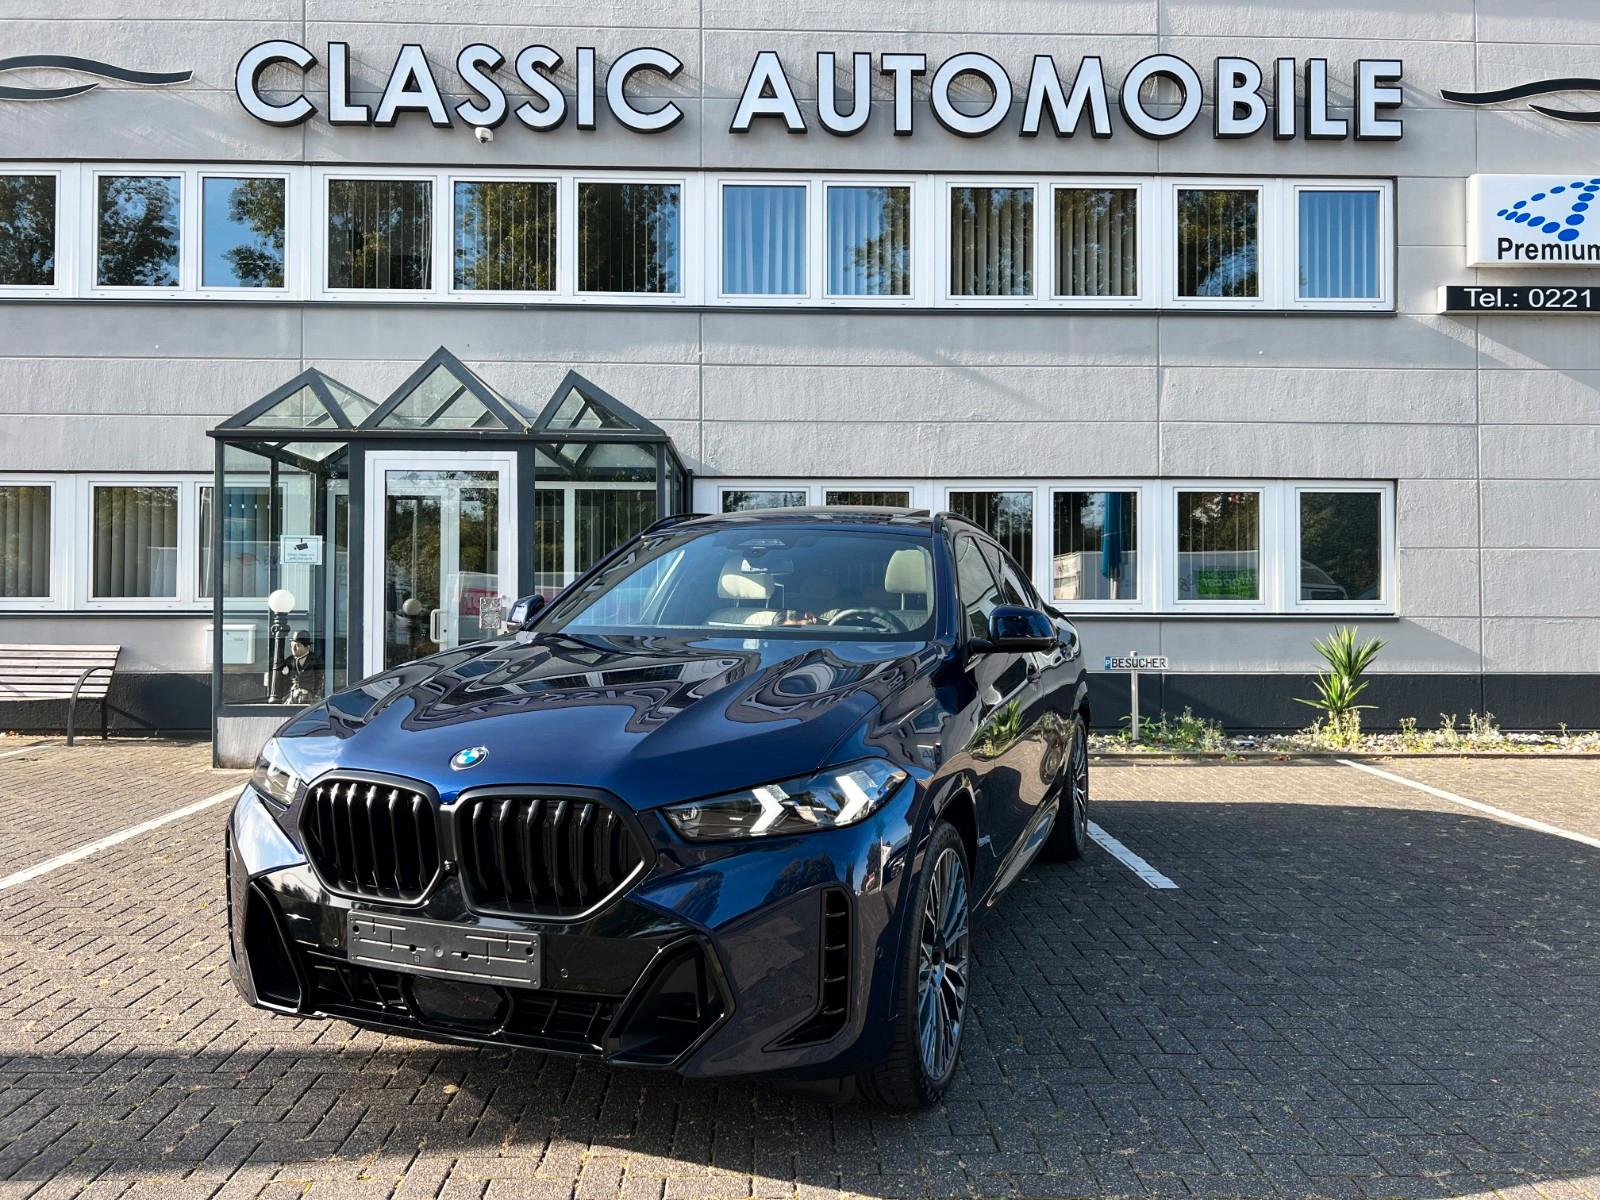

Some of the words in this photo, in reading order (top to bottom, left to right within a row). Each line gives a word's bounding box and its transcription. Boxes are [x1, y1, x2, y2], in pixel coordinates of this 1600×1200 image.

[235, 39, 685, 134] CLASSIC
[729, 51, 1404, 141] AUTOMOBILE
[1497, 237, 1600, 261] Premium
[1463, 287, 1518, 308] Tel.:
[1528, 288, 1592, 309] 0221
[1111, 657, 1167, 669] BESUCHER
